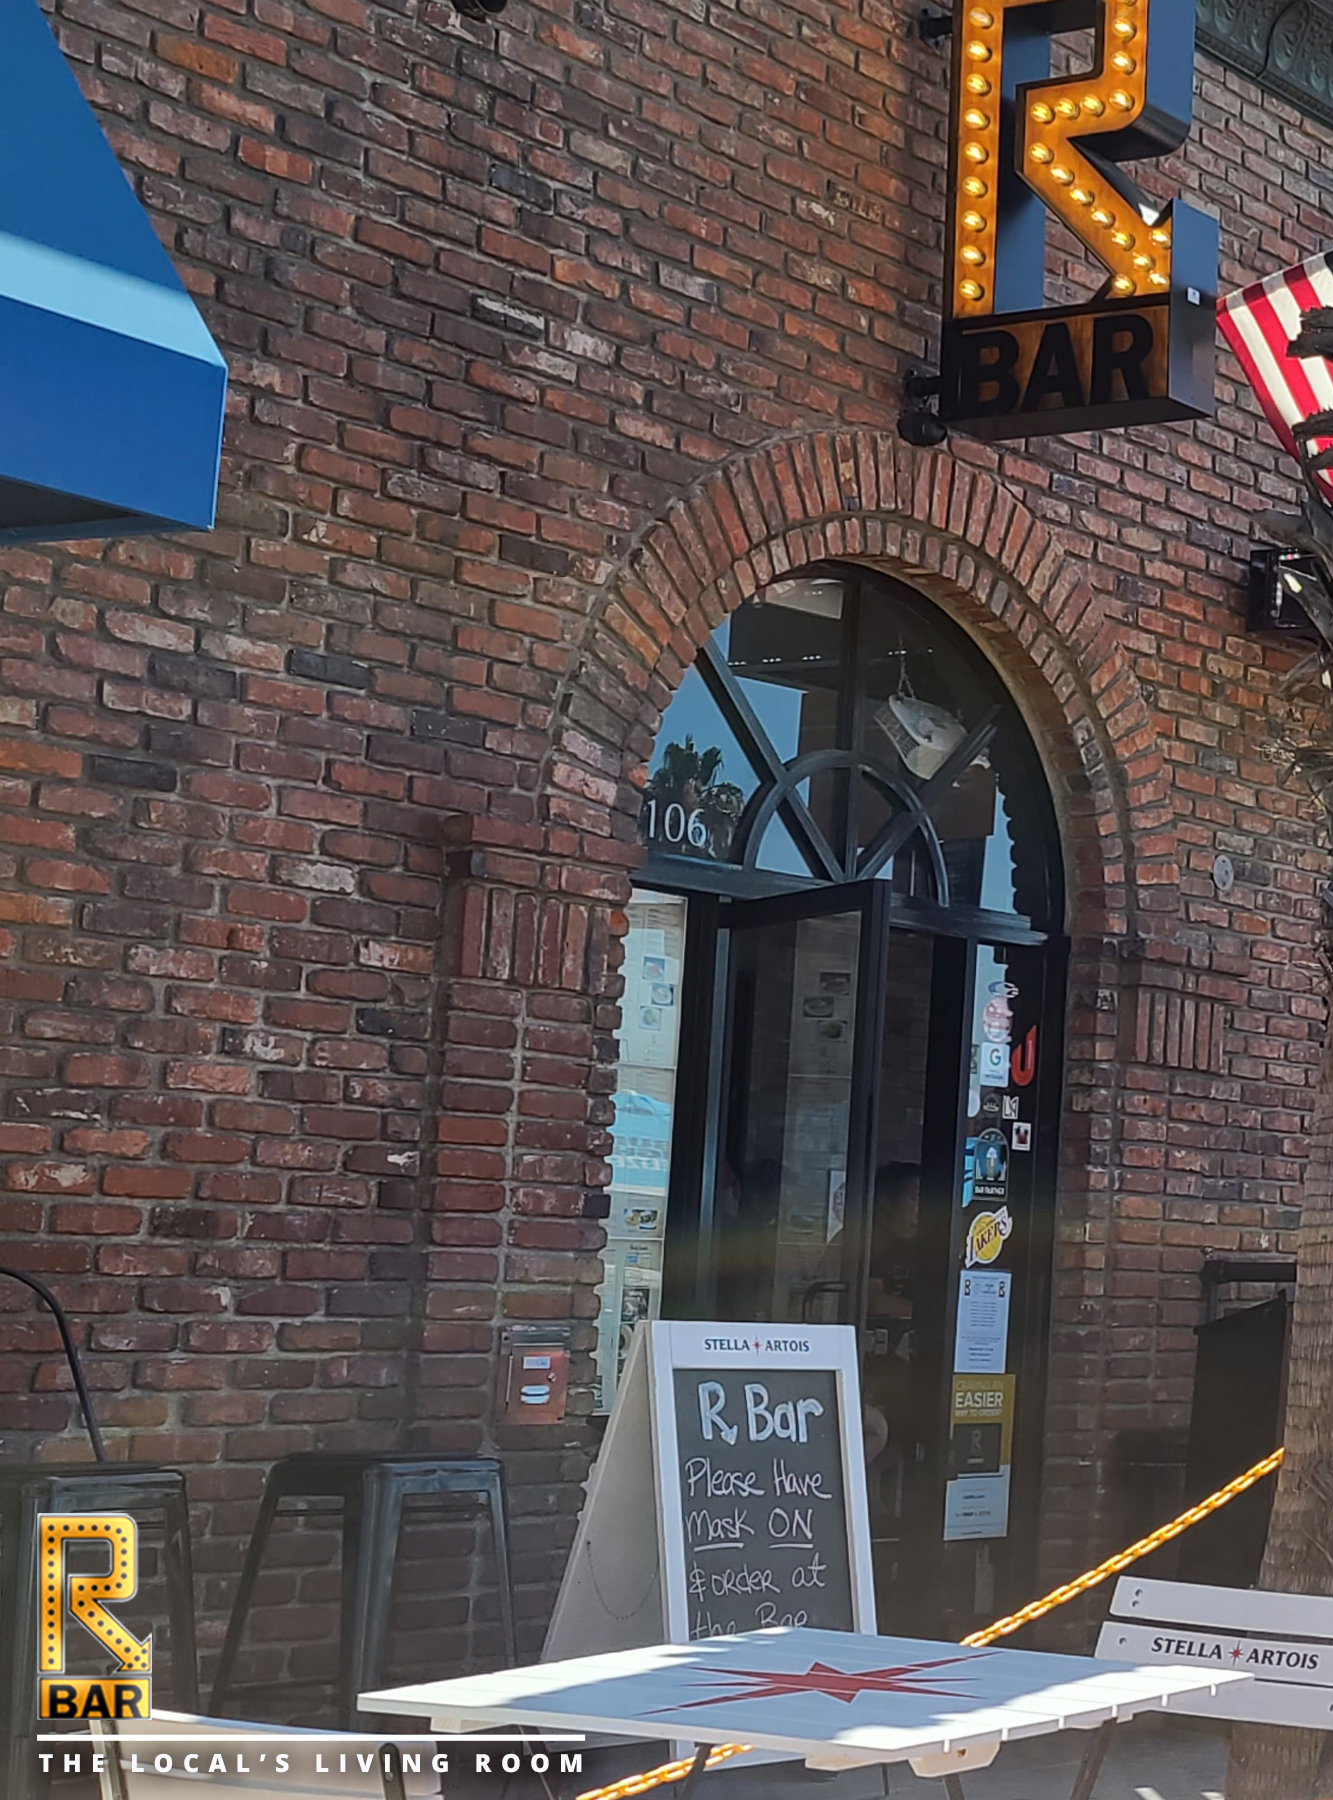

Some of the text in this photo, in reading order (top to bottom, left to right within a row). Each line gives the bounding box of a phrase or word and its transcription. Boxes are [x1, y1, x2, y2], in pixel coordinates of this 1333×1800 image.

[953, 0, 1172, 318] R
[958, 313, 1155, 418] BAR
[648, 800, 707, 847] 106
[704, 1338, 810, 1352] STELLA ARTOIS
[698, 1381, 824, 1445] R Bar
[955, 1391, 1004, 1408] EASIER
[685, 1456, 833, 1500] Please Have
[768, 1506, 813, 1540] ON
[792, 1552, 827, 1588] at
[1151, 1637, 1319, 1669] STELLA ARTOIS
